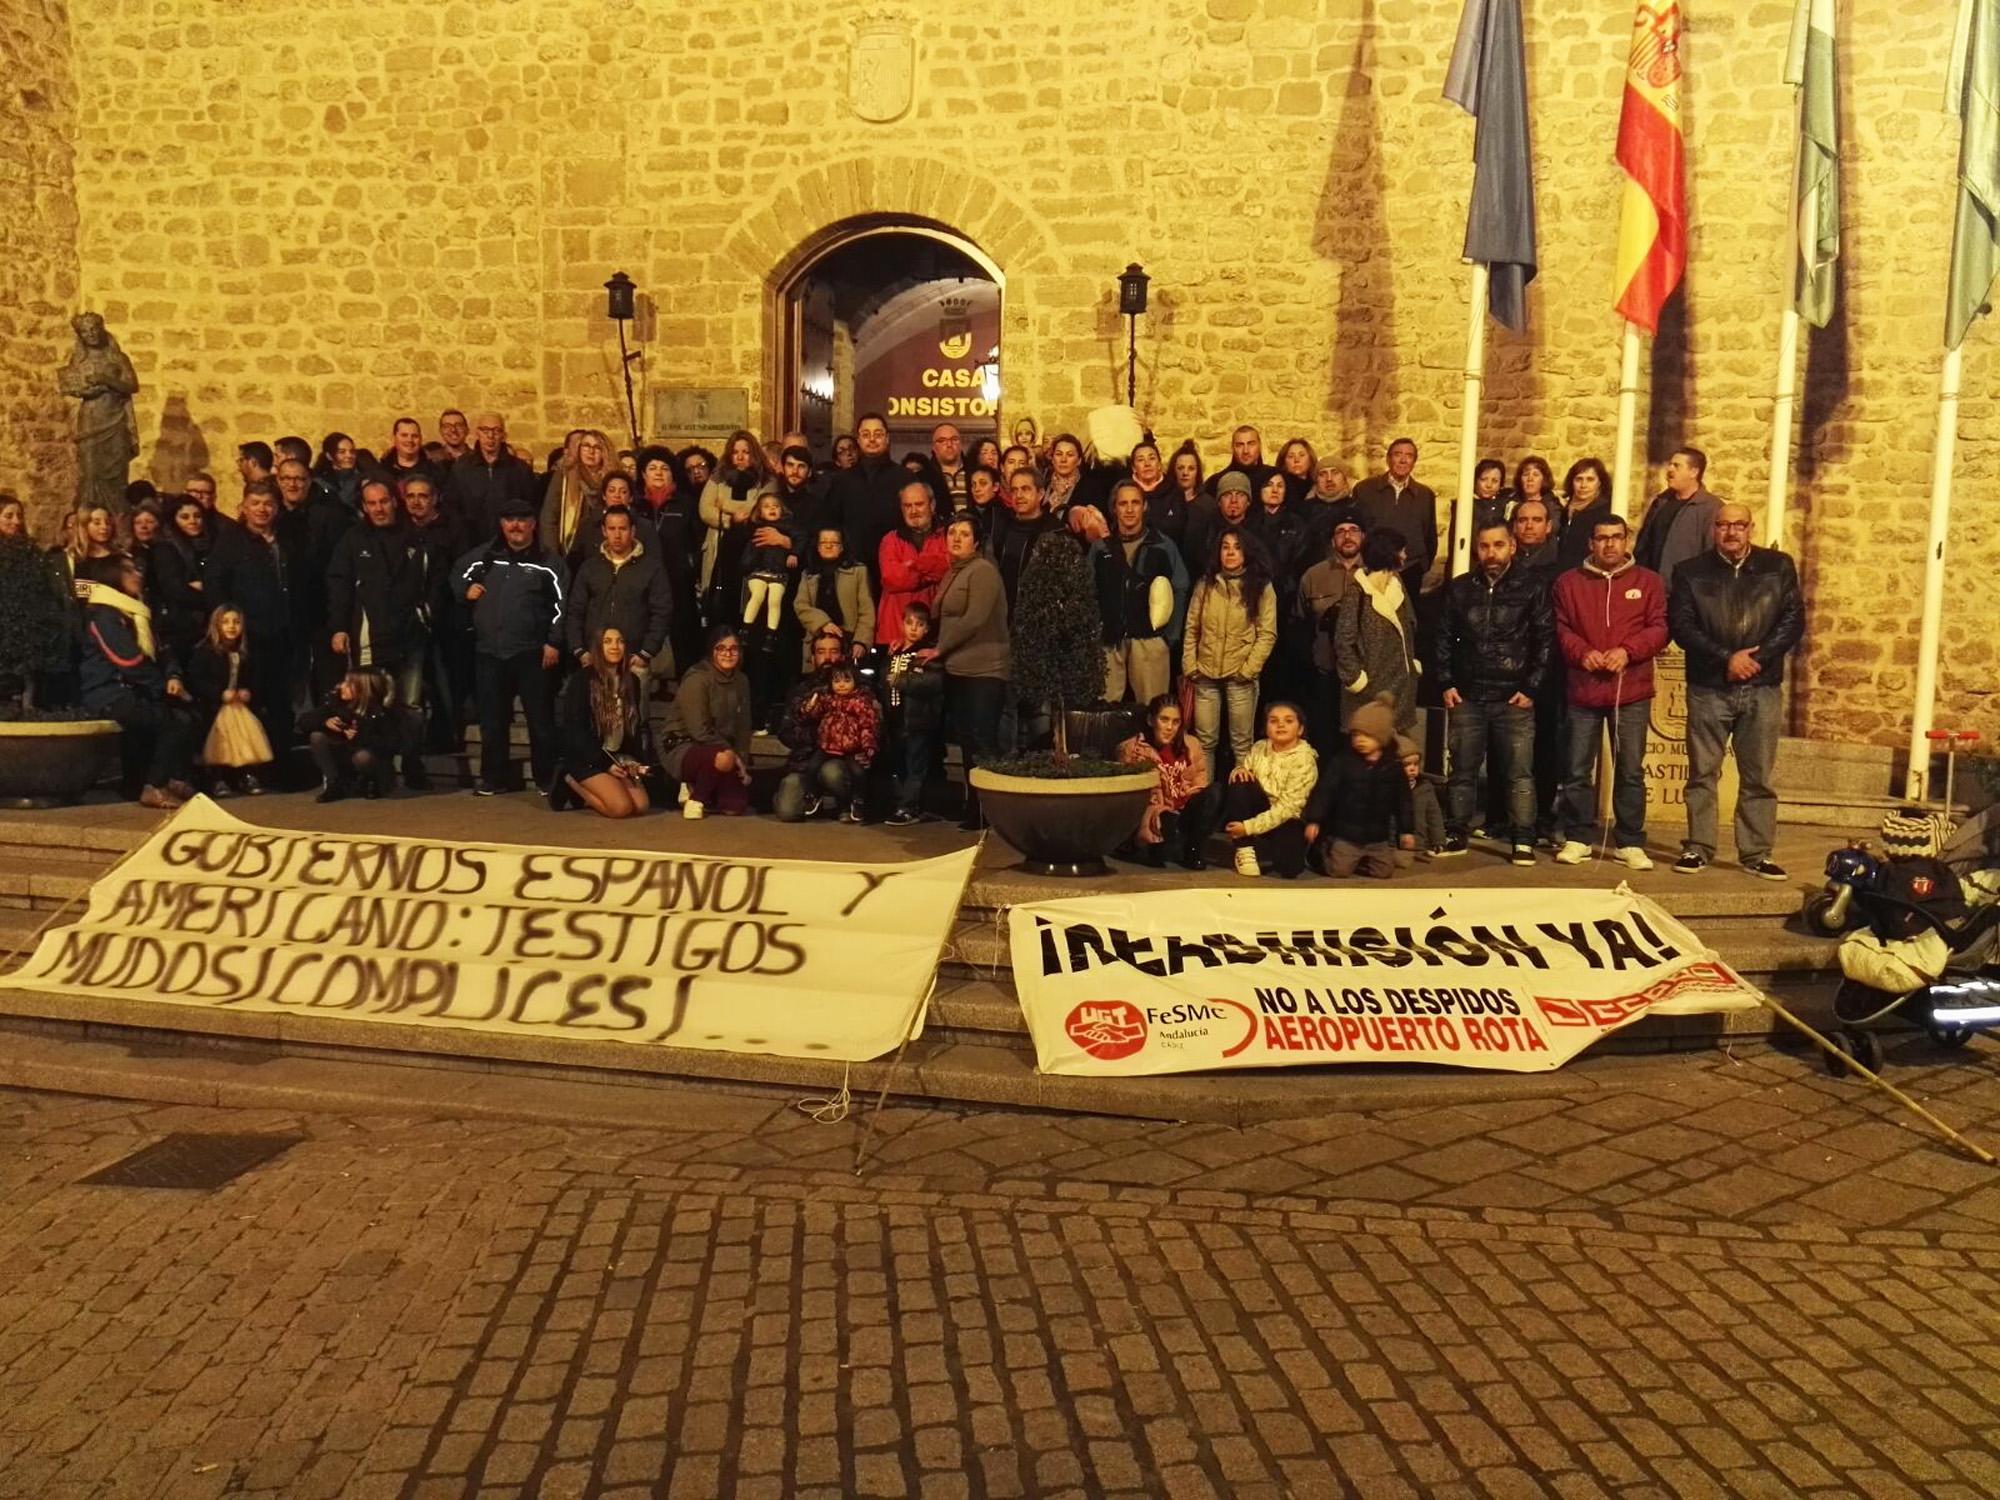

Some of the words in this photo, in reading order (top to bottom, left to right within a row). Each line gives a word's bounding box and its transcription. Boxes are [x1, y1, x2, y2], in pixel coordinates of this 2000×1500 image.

[922, 368, 986, 388] CASA
[161, 828, 499, 894] GOBIERNOS
[513, 853, 788, 916] ESPAÑOL
[840, 870, 904, 917] Y
[38, 930, 248, 997] MUDOS
[480, 903, 808, 976] TESTIGOS
[1536, 910, 1682, 971] YA!
[1080, 1006, 1128, 1027] UGT
[1254, 987, 1298, 1014] NO
[1304, 988, 1327, 1014] A
[1326, 988, 1384, 1014] LOS
[1383, 988, 1521, 1015] DESPIDOS
[1263, 1016, 1460, 1051] AEROPUERTO
[1462, 1017, 1549, 1051] ROTA
